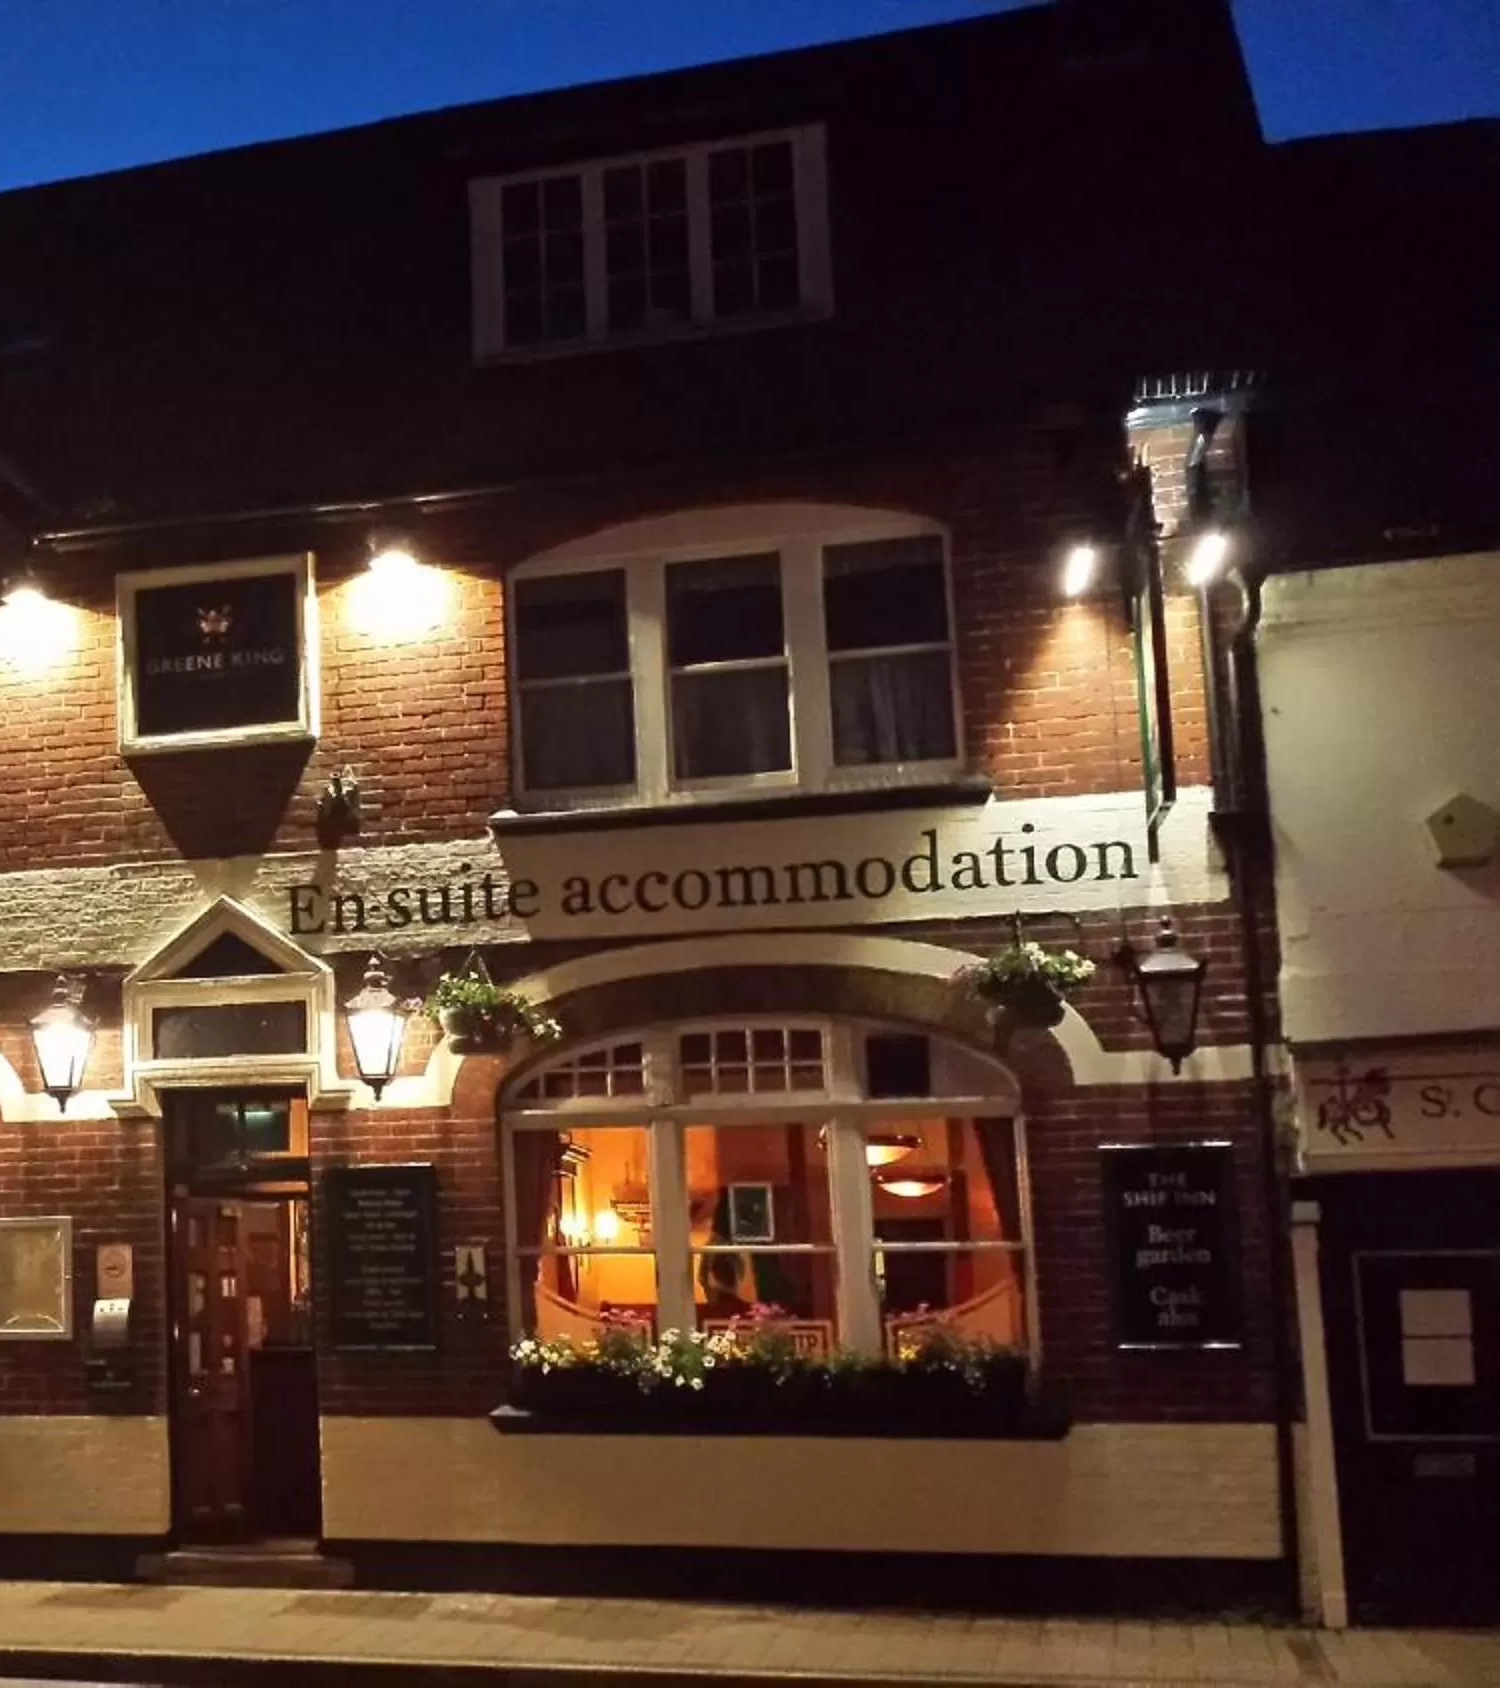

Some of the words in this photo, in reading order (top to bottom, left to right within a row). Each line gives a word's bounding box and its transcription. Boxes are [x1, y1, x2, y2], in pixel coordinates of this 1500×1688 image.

[146, 652, 223, 677] GREENE
[231, 647, 286, 667] KING
[561, 822, 1139, 917] accommodation
